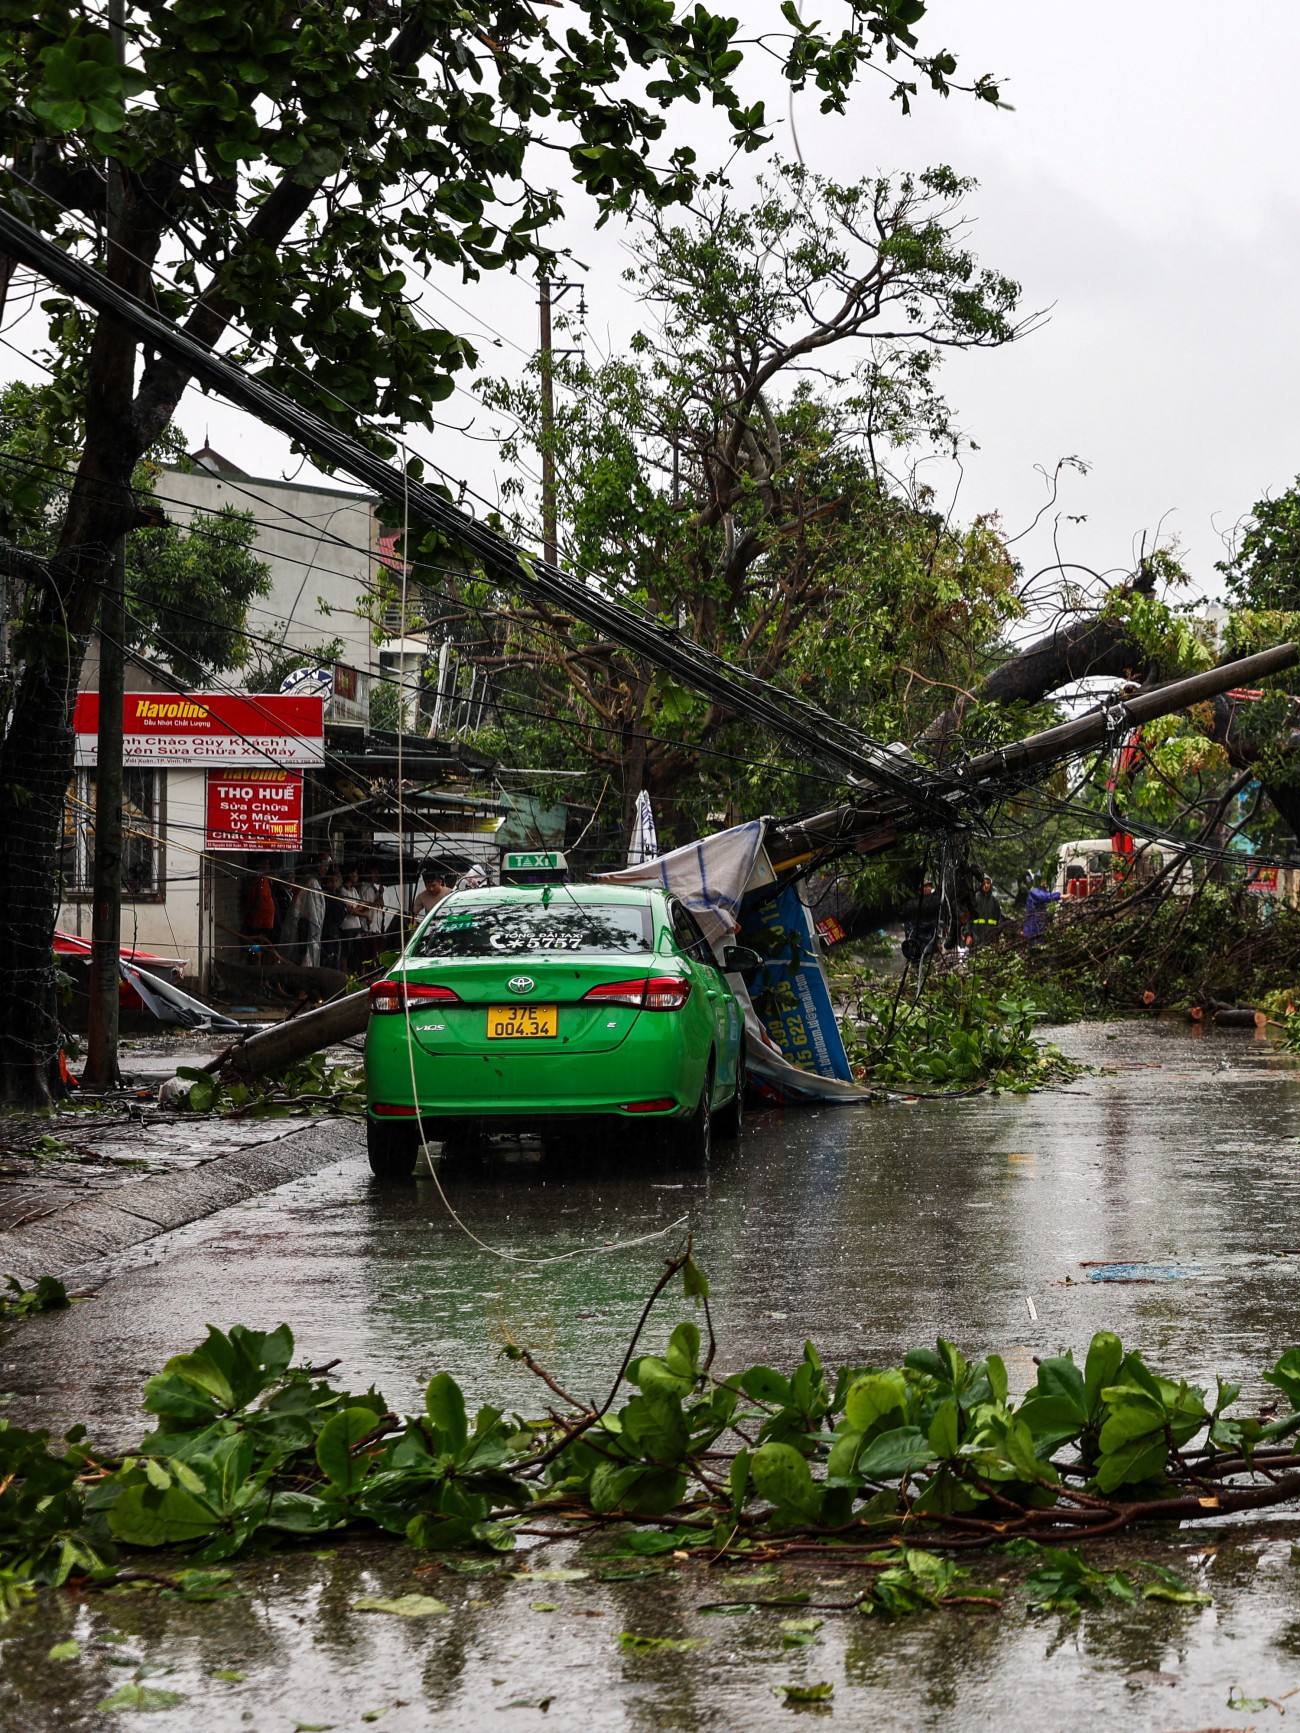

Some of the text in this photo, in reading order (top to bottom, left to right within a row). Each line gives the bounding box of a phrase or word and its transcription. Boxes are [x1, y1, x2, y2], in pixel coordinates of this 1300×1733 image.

[136, 700, 210, 718] Havoline
[145, 737, 188, 746] Chào
[157, 746, 189, 755] Sửa
[193, 747, 236, 756] Chữa
[265, 747, 296, 757] Máy
[217, 787, 253, 802] THỌ
[220, 802, 288, 812] Sửa Chữa
[230, 812, 279, 821] Xe Máy
[231, 821, 249, 831] Uy
[505, 931, 536, 939] TỔNG
[538, 931, 558, 939] ĐÀI
[508, 1007, 538, 1021] 37E
[495, 1022, 549, 1036] 004.34
[789, 1014, 808, 1046] 622
